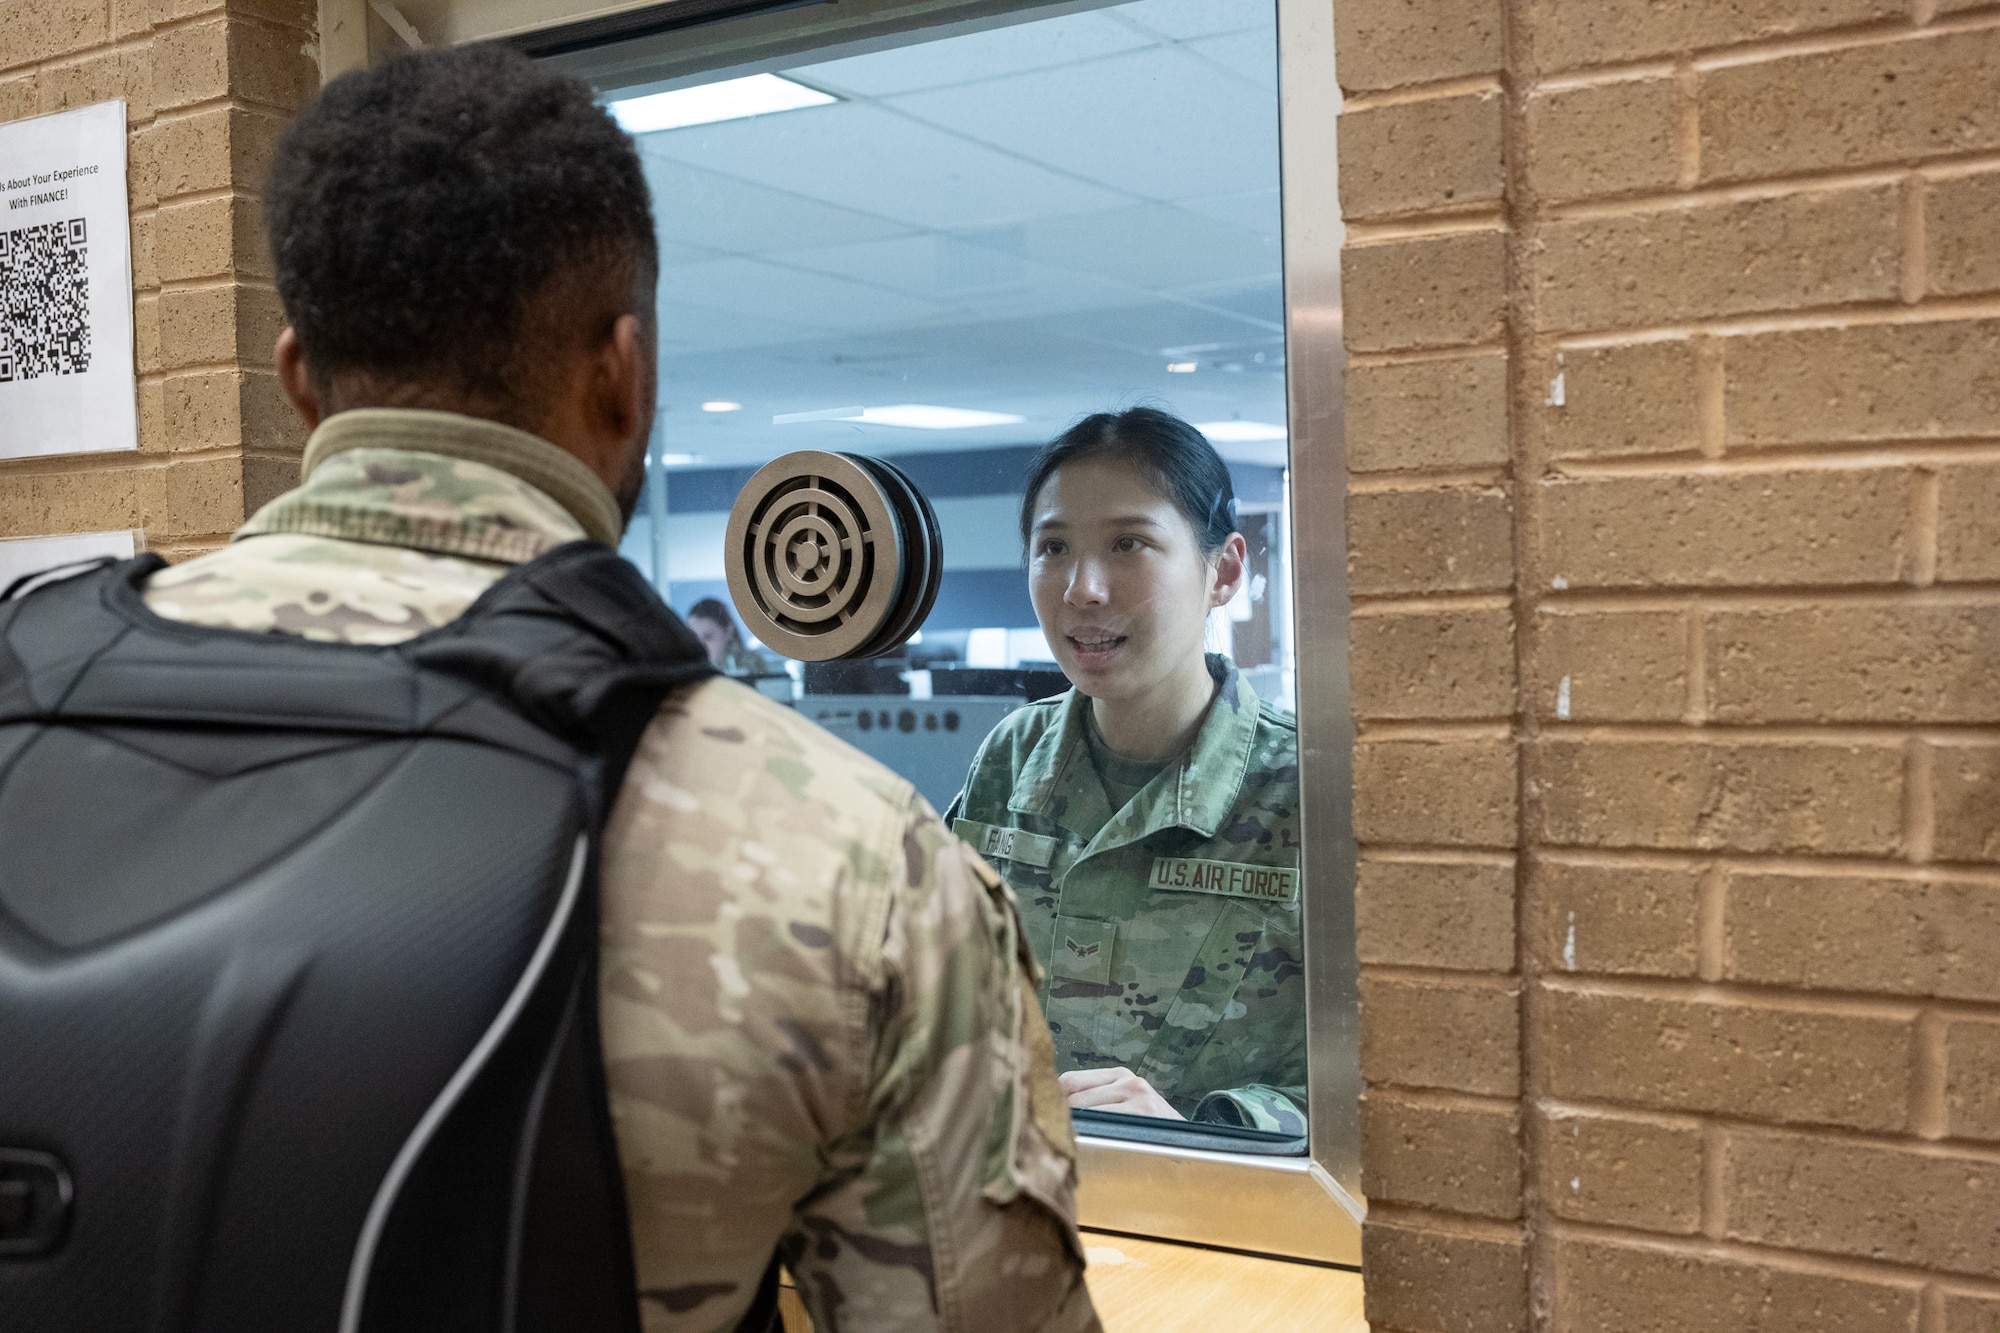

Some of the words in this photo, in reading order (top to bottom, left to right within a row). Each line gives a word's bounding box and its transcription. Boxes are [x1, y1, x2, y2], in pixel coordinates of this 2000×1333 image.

[0, 182, 6, 191] s
[7, 178, 31, 190] About
[32, 174, 51, 185] Your
[53, 164, 99, 182] Experience
[9, 197, 28, 210] With
[30, 188, 69, 206] FINANCE!
[1229, 866, 1291, 898] FORCE
